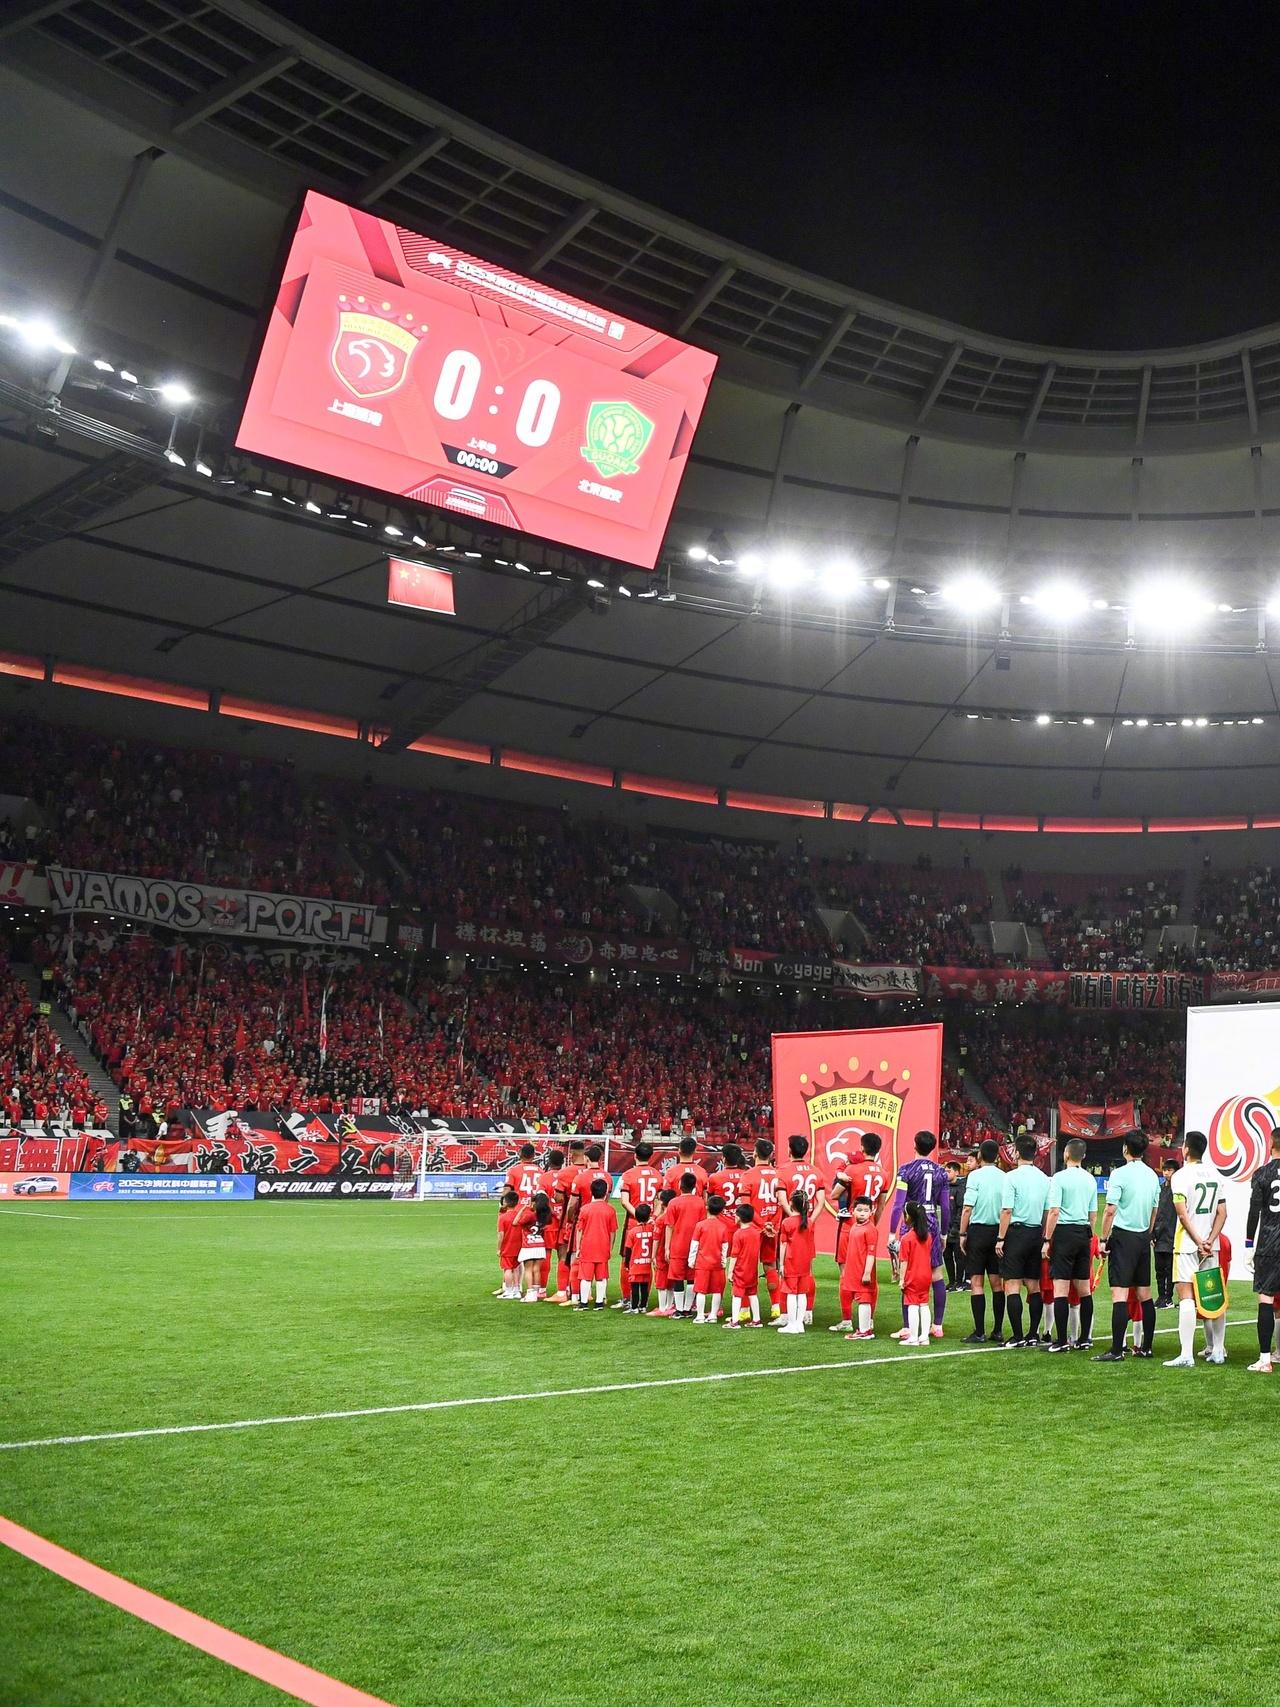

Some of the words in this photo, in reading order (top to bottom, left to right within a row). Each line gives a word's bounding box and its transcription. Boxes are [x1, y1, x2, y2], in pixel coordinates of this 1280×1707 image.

[433, 349, 482, 421] 0
[515, 379, 561, 447] 0
[457, 450, 499, 474] 00:00
[50, 868, 203, 928] VAMOS
[246, 894, 378, 945] PORT!
[455, 921, 547, 953] 襟怀坦荡
[599, 941, 679, 961] 赤胆忠心
[773, 960, 833, 982] voyage
[926, 972, 1066, 1003] 在一起就美好
[811, 1092, 899, 1116] 上海海港足球俱乐部
[813, 1108, 856, 1124] SHANGHAI
[859, 1108, 883, 1119] PORT
[885, 1113, 897, 1124] FC
[288, 1181, 337, 1193] ONLINE
[637, 1177, 658, 1202] 15
[757, 1177, 779, 1204] 40
[791, 1173, 818, 1200] 26
[863, 1174, 884, 1201] 13
[923, 1173, 934, 1202] 1
[1194, 1181, 1218, 1215] 27
[641, 1238, 650, 1258] 5
